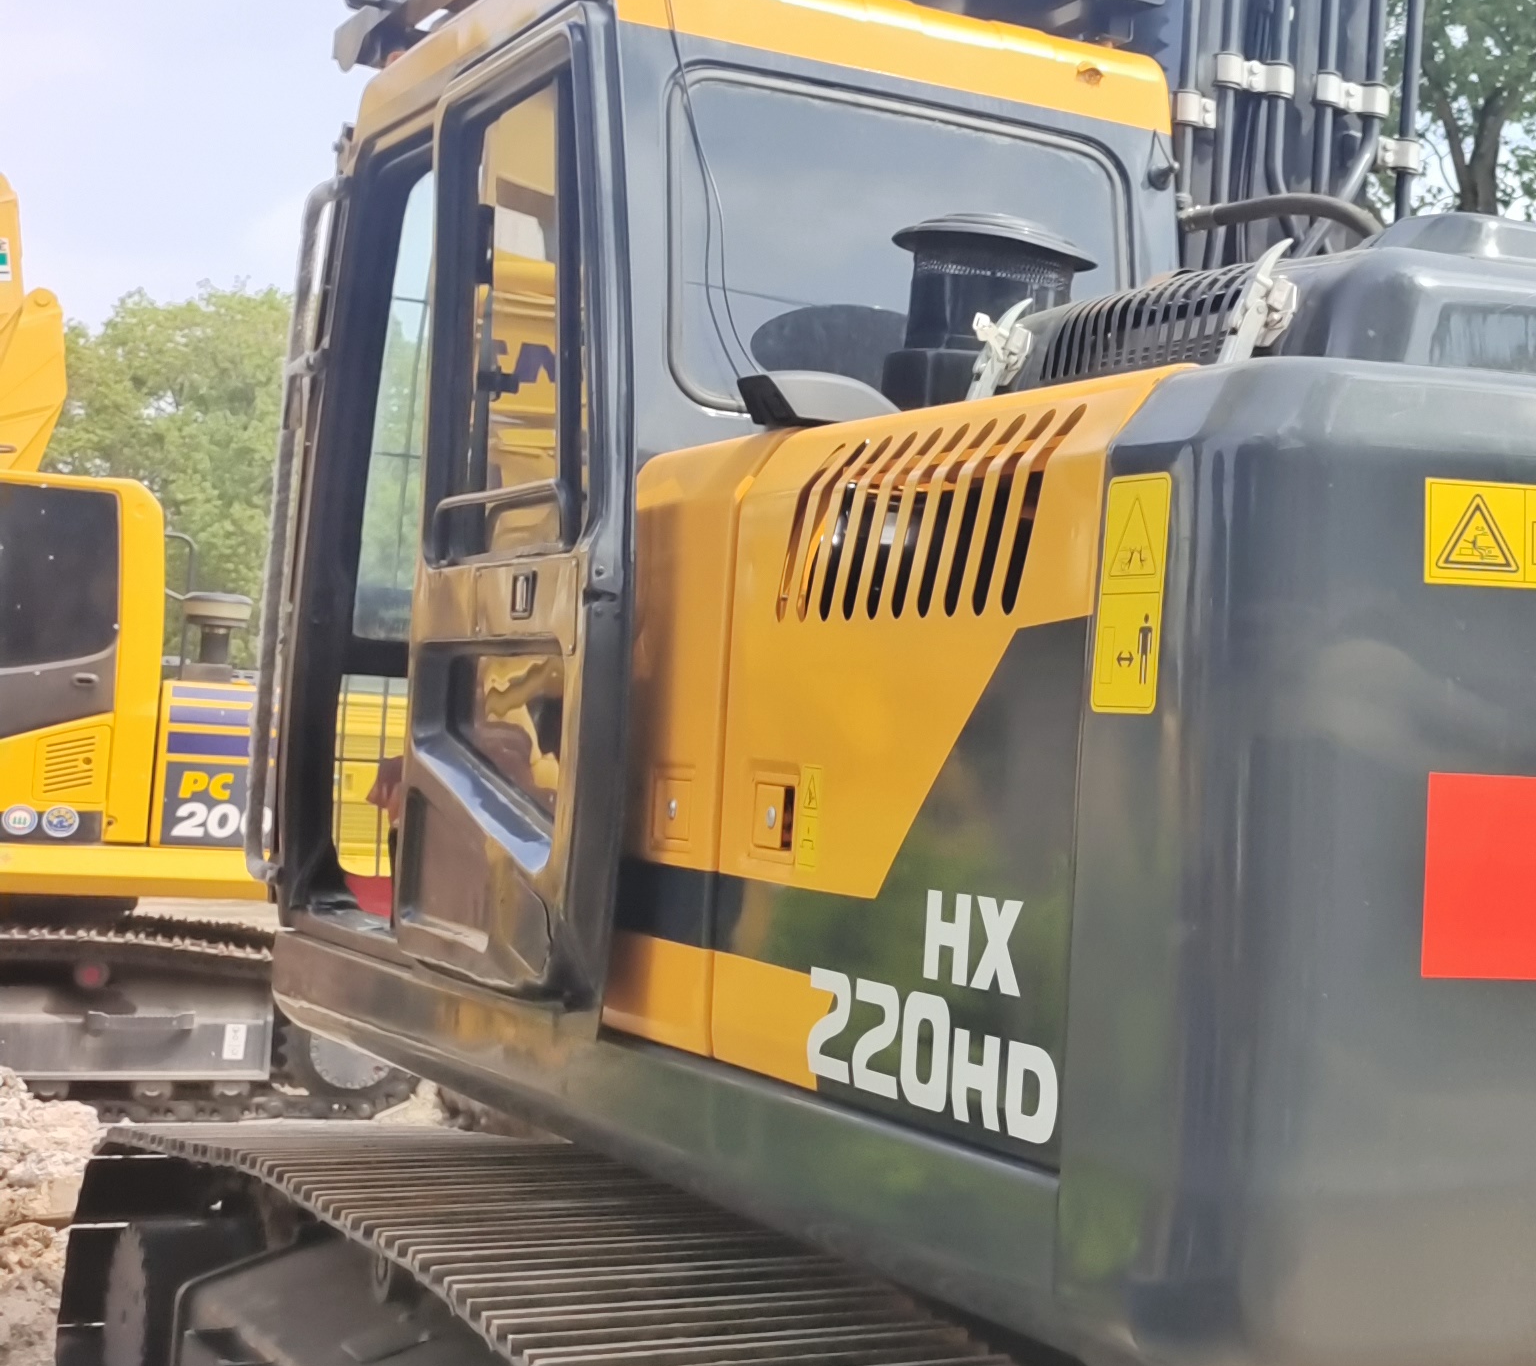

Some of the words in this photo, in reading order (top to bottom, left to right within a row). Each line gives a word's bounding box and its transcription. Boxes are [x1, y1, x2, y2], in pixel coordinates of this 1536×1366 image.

[178, 771, 235, 801] PC
[923, 889, 1024, 997] HX
[806, 966, 1058, 1144] 220HD
